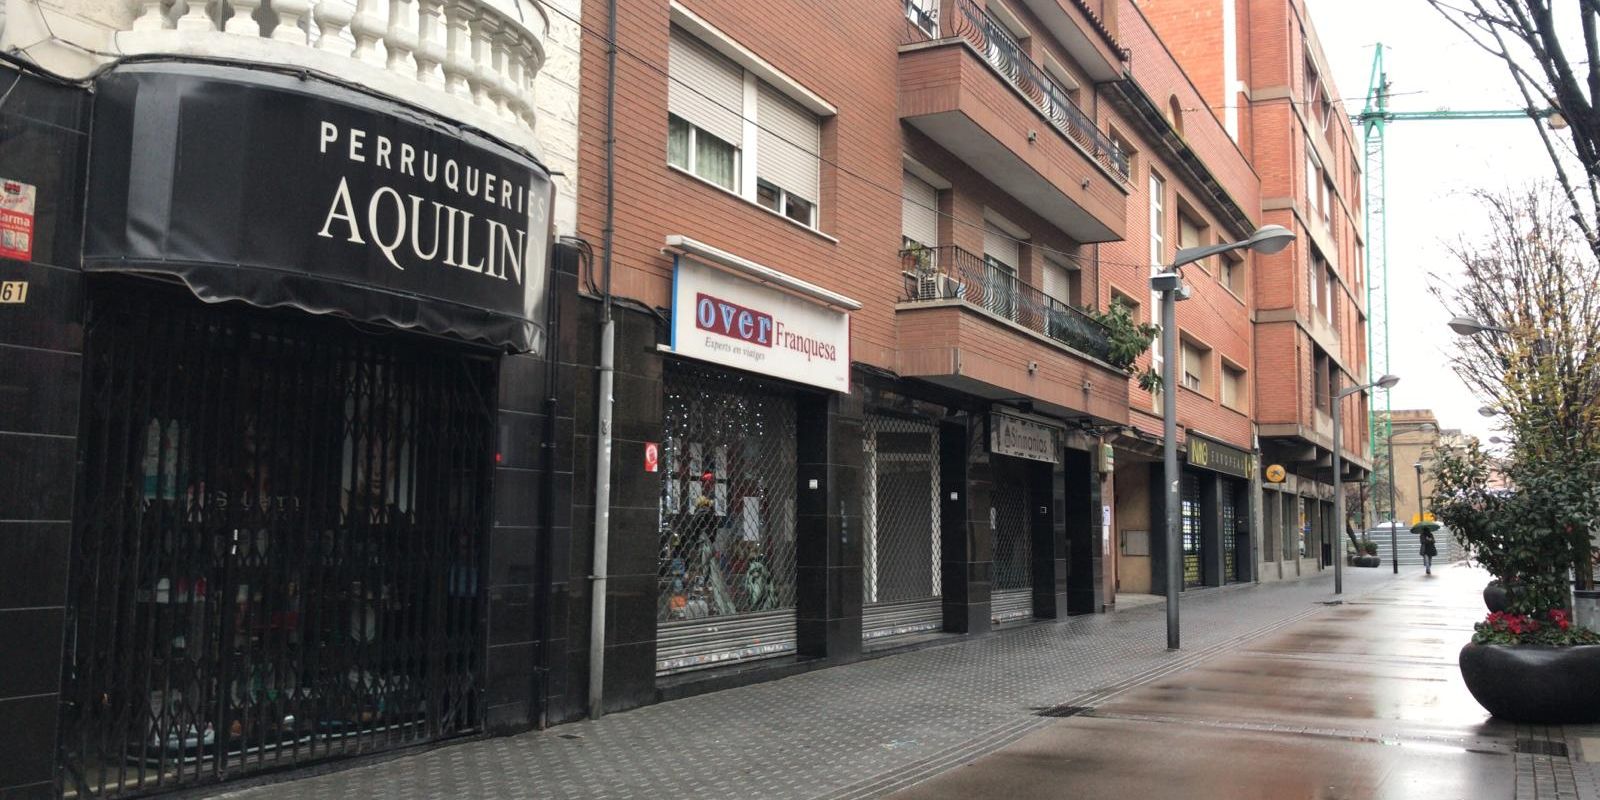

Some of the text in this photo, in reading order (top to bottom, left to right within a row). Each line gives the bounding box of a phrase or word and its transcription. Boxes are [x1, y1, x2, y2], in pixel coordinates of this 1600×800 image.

[320, 121, 544, 222] PERRUQUERIES
[318, 176, 541, 291] AQUILINO
[2, 282, 25, 301] 61
[698, 298, 836, 362] over Franquesa
[704, 337, 731, 353] Experts
[733, 345, 743, 356] en
